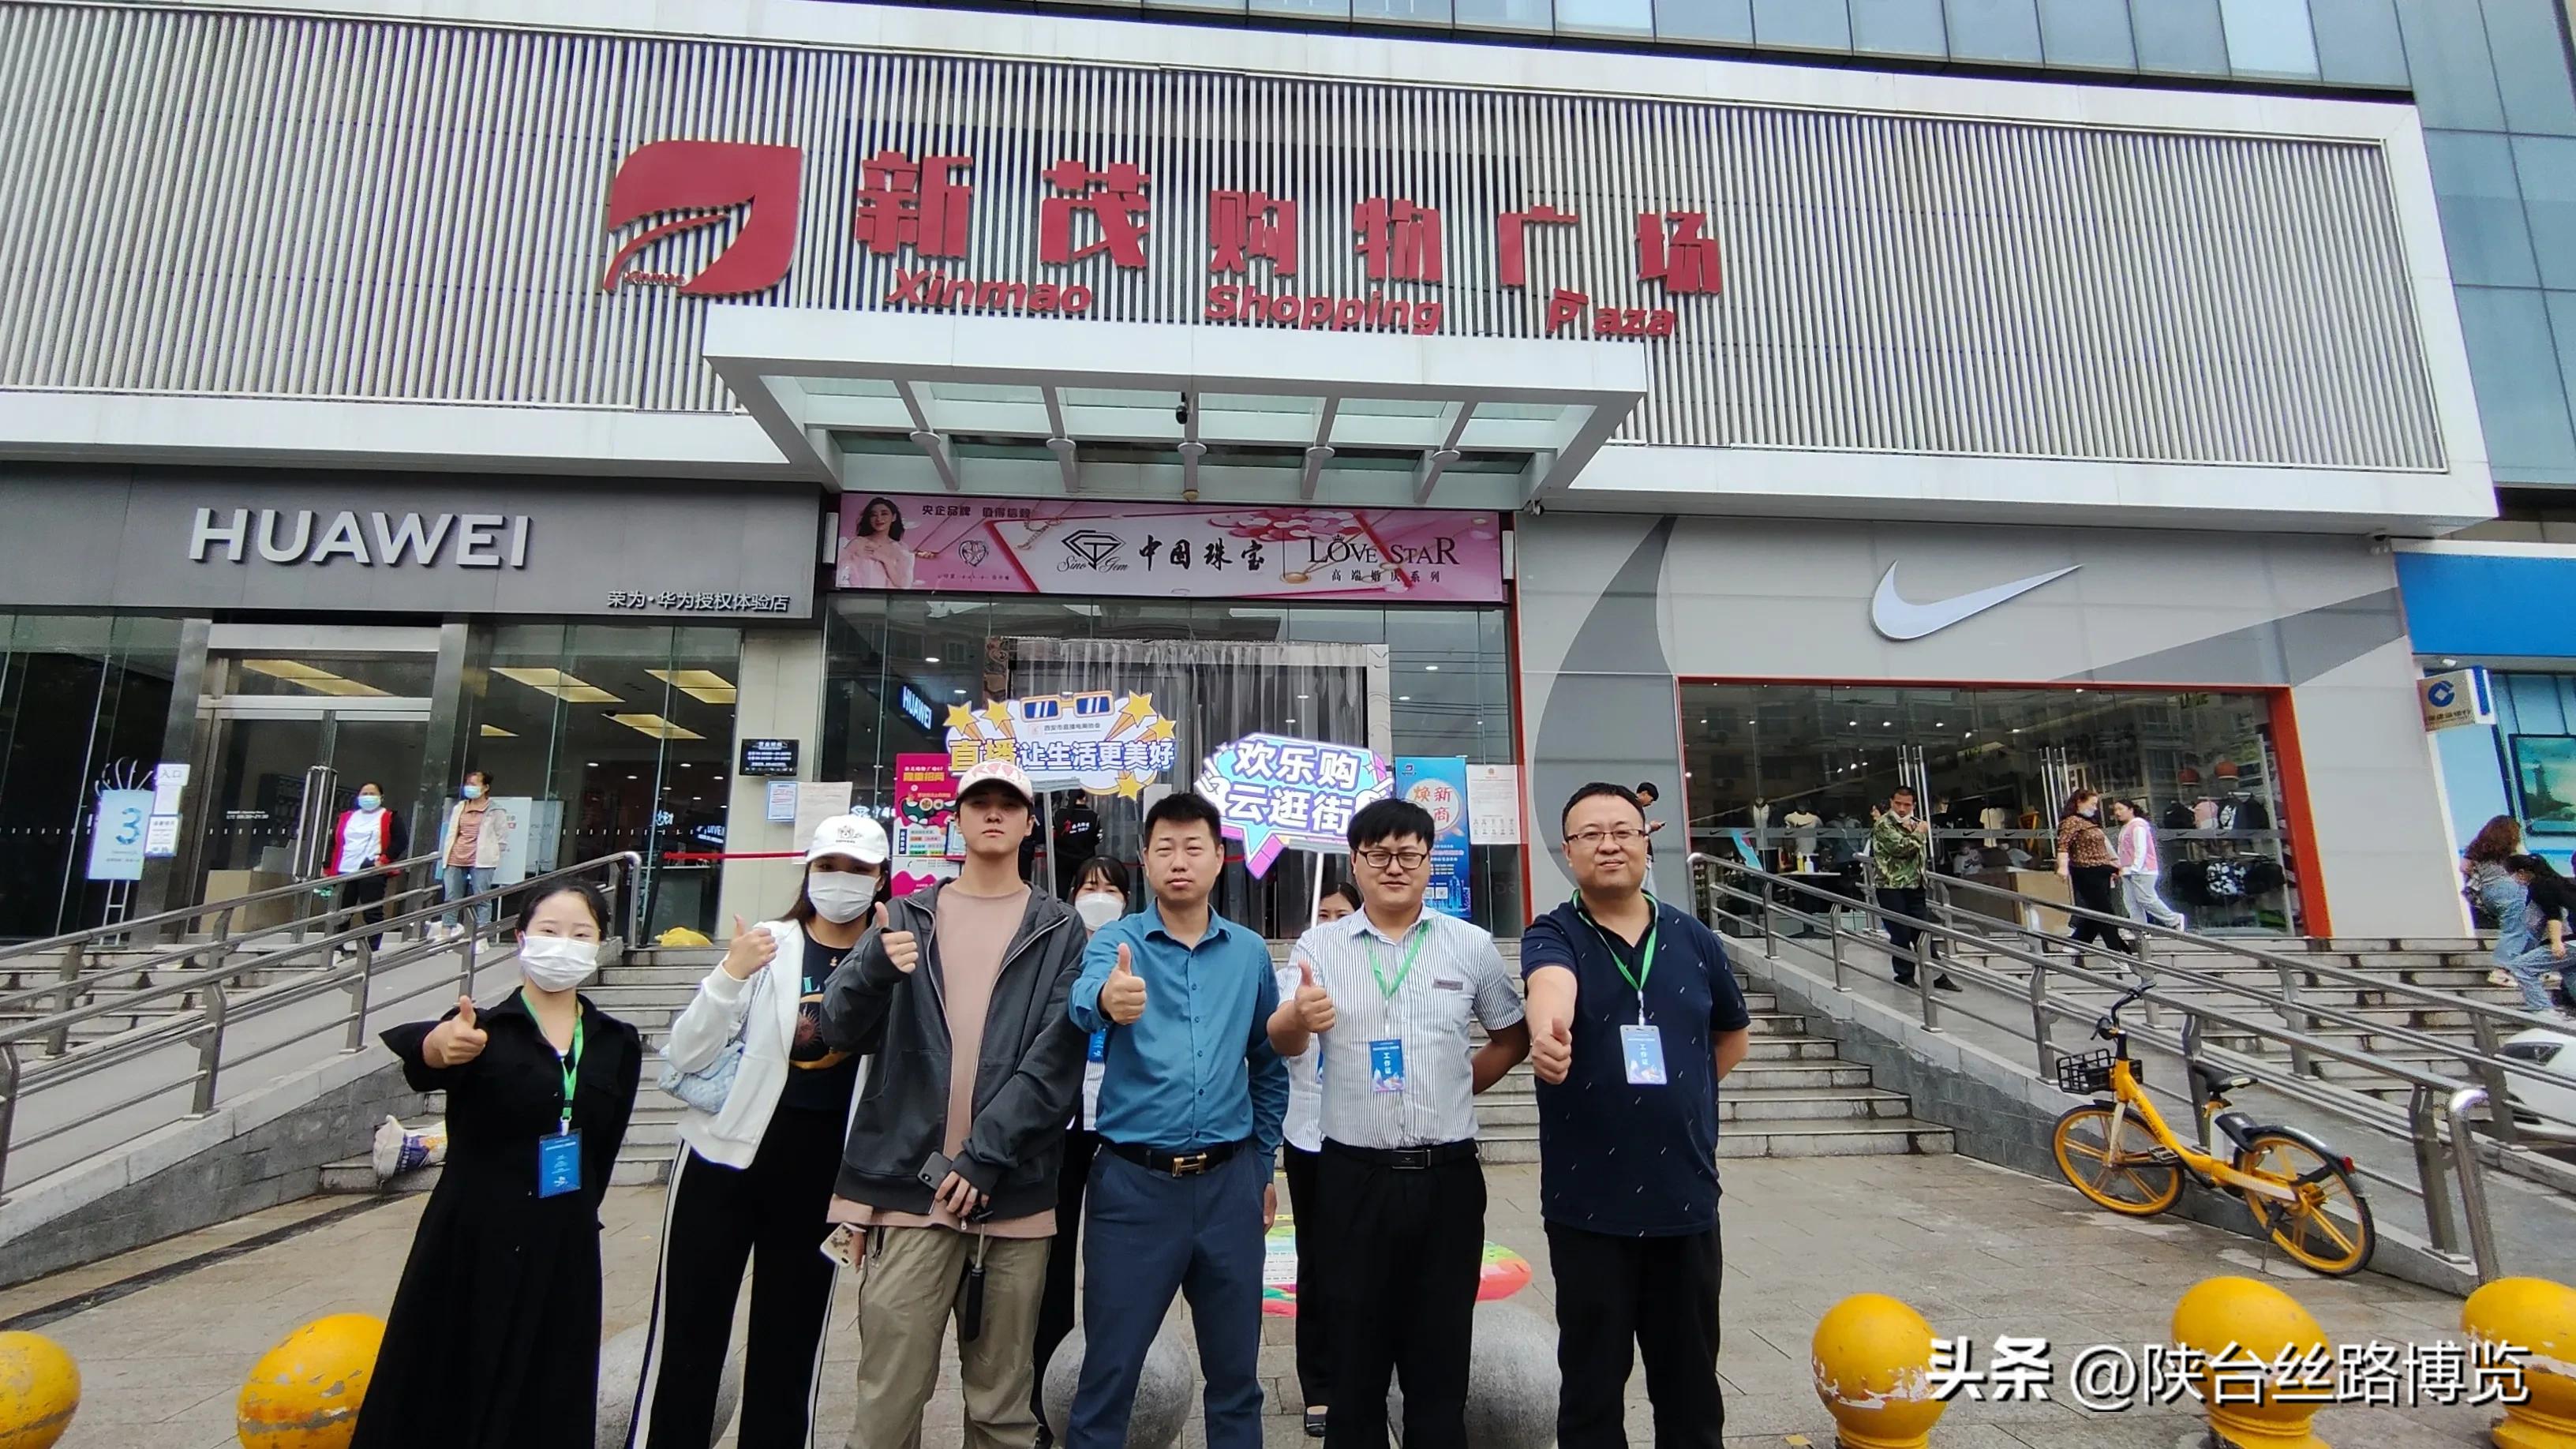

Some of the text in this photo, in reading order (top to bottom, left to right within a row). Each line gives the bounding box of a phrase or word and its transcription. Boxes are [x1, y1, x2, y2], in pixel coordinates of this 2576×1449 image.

[855, 150, 1722, 295] 新茂购物广场
[885, 268, 1093, 314] Xinmao
[1205, 284, 1443, 335] Shopping
[922, 504, 972, 517] 央企品牌
[189, 507, 531, 569] HUAWEI
[1139, 534, 1266, 572] 中国珠宝
[1309, 536, 1460, 566] LOVE STAR
[1056, 555, 1087, 573] Sino
[903, 685, 932, 730] HUAWEI
[160, 767, 182, 779] 入口
[948, 738, 1175, 773] 直播让生活更美好
[1235, 740, 1359, 788] 欢乐购
[115, 807, 142, 845] 3
[1226, 785, 1353, 835] 云逛街
[1433, 807, 1451, 823] 商
